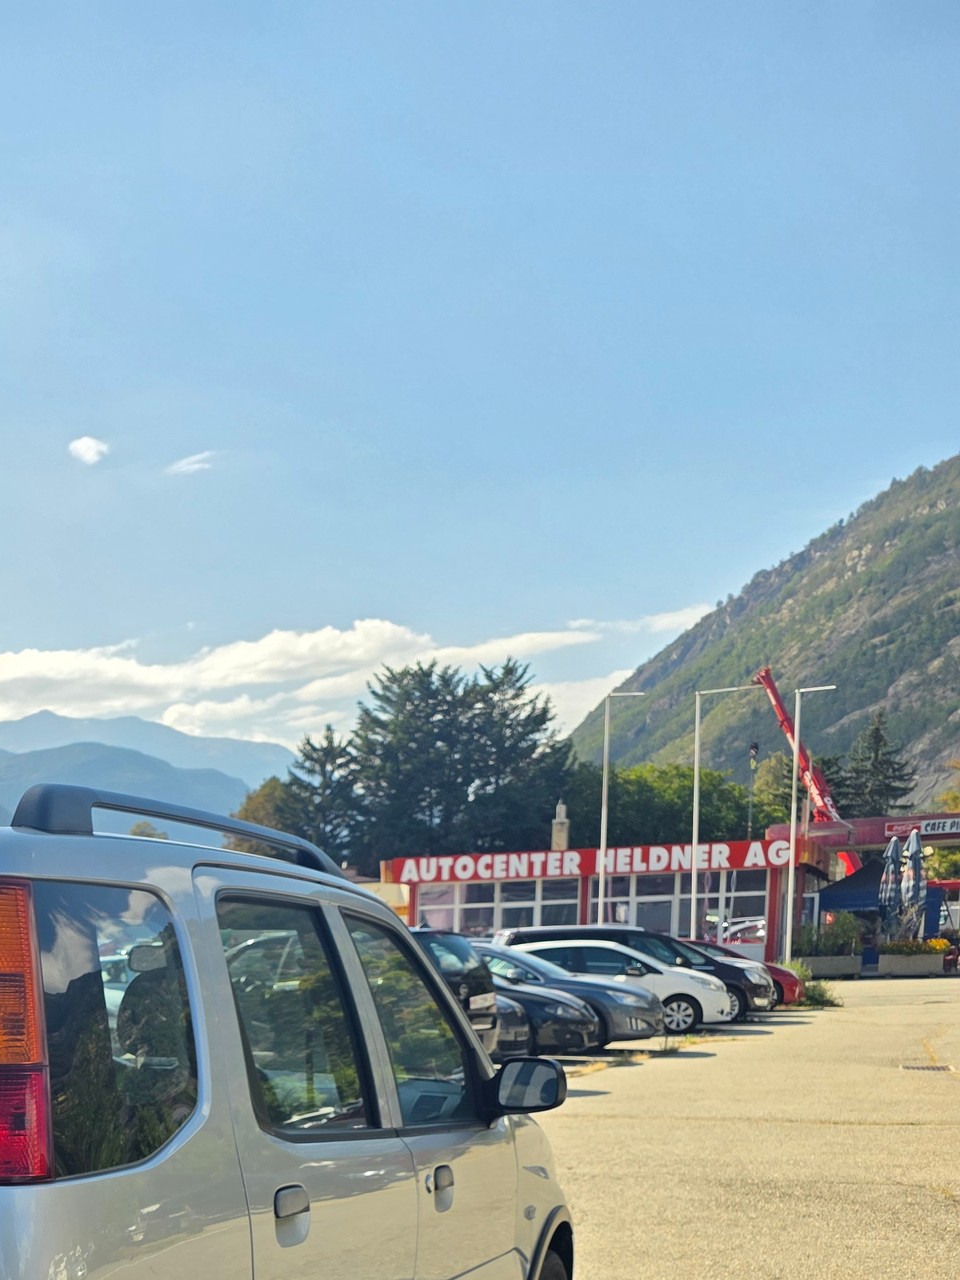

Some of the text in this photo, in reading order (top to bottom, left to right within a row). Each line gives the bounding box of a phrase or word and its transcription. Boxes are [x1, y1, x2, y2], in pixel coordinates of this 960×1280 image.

[924, 821, 947, 833] CAFE
[949, 820, 960, 831] PI
[399, 840, 790, 883] AUTOCENTER HELDNER AG
